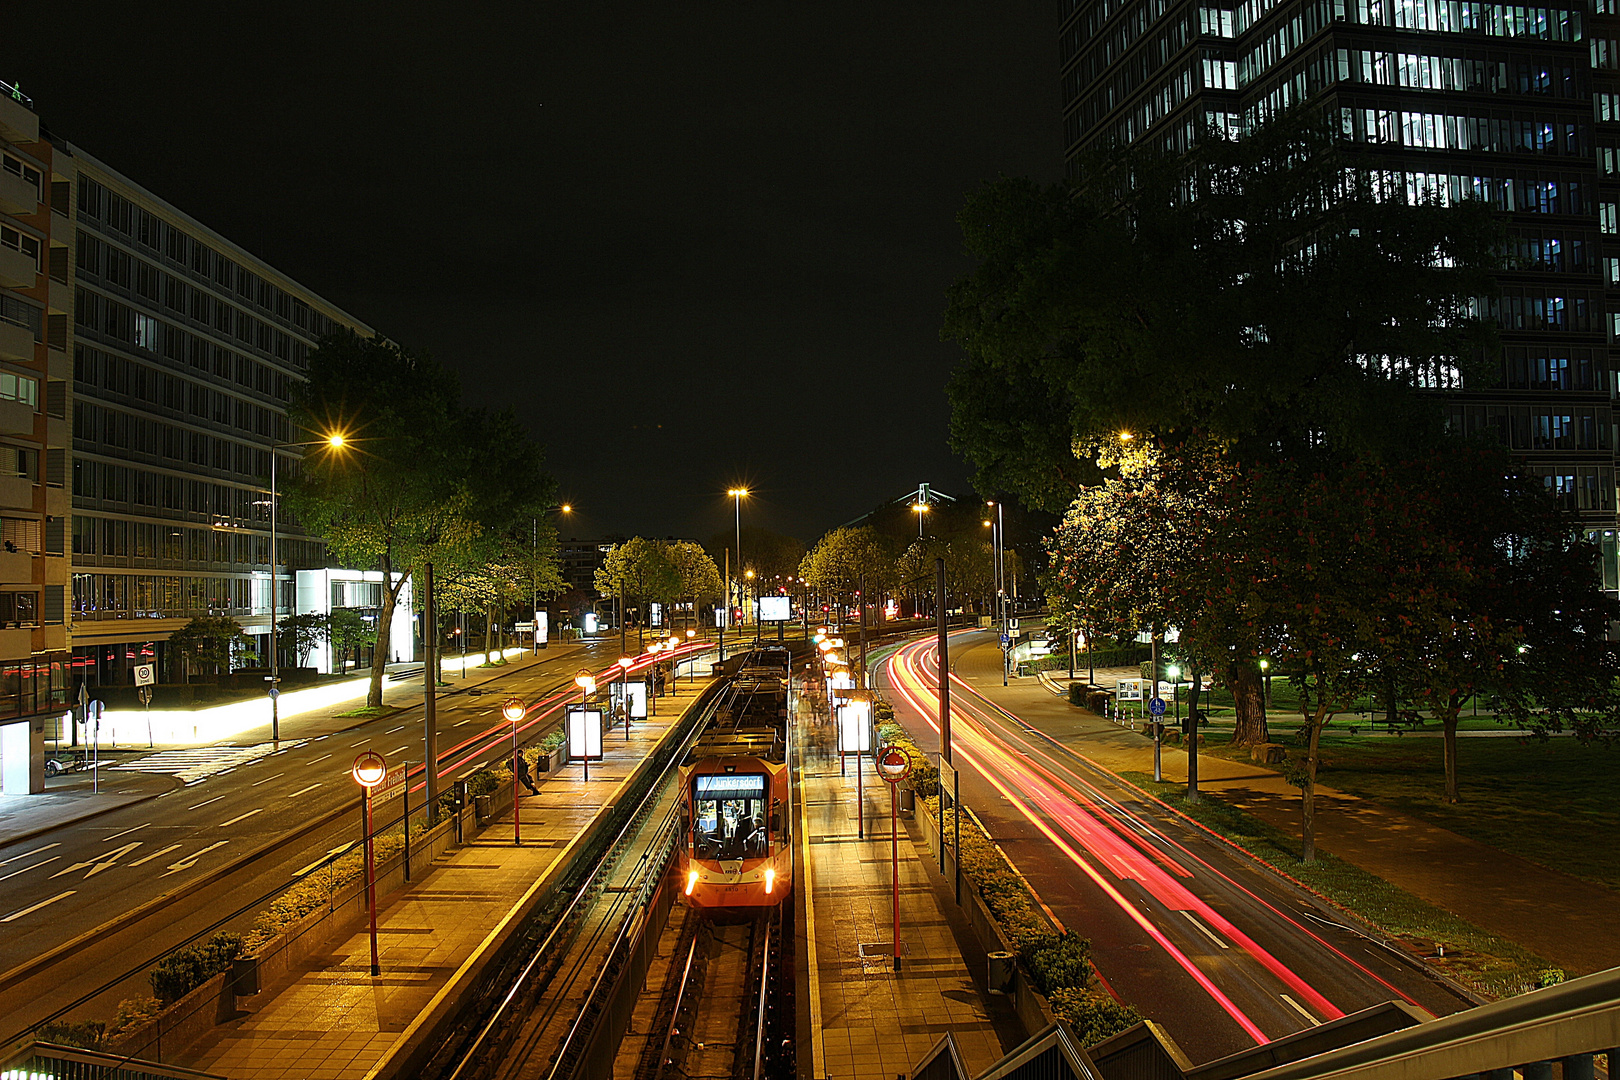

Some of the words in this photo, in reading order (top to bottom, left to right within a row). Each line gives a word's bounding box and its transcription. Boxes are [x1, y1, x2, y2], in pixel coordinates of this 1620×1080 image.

[1010, 619, 1018, 629] U
[387, 768, 405, 787] Freiheit
[714, 776, 761, 788] Junkersdorf
